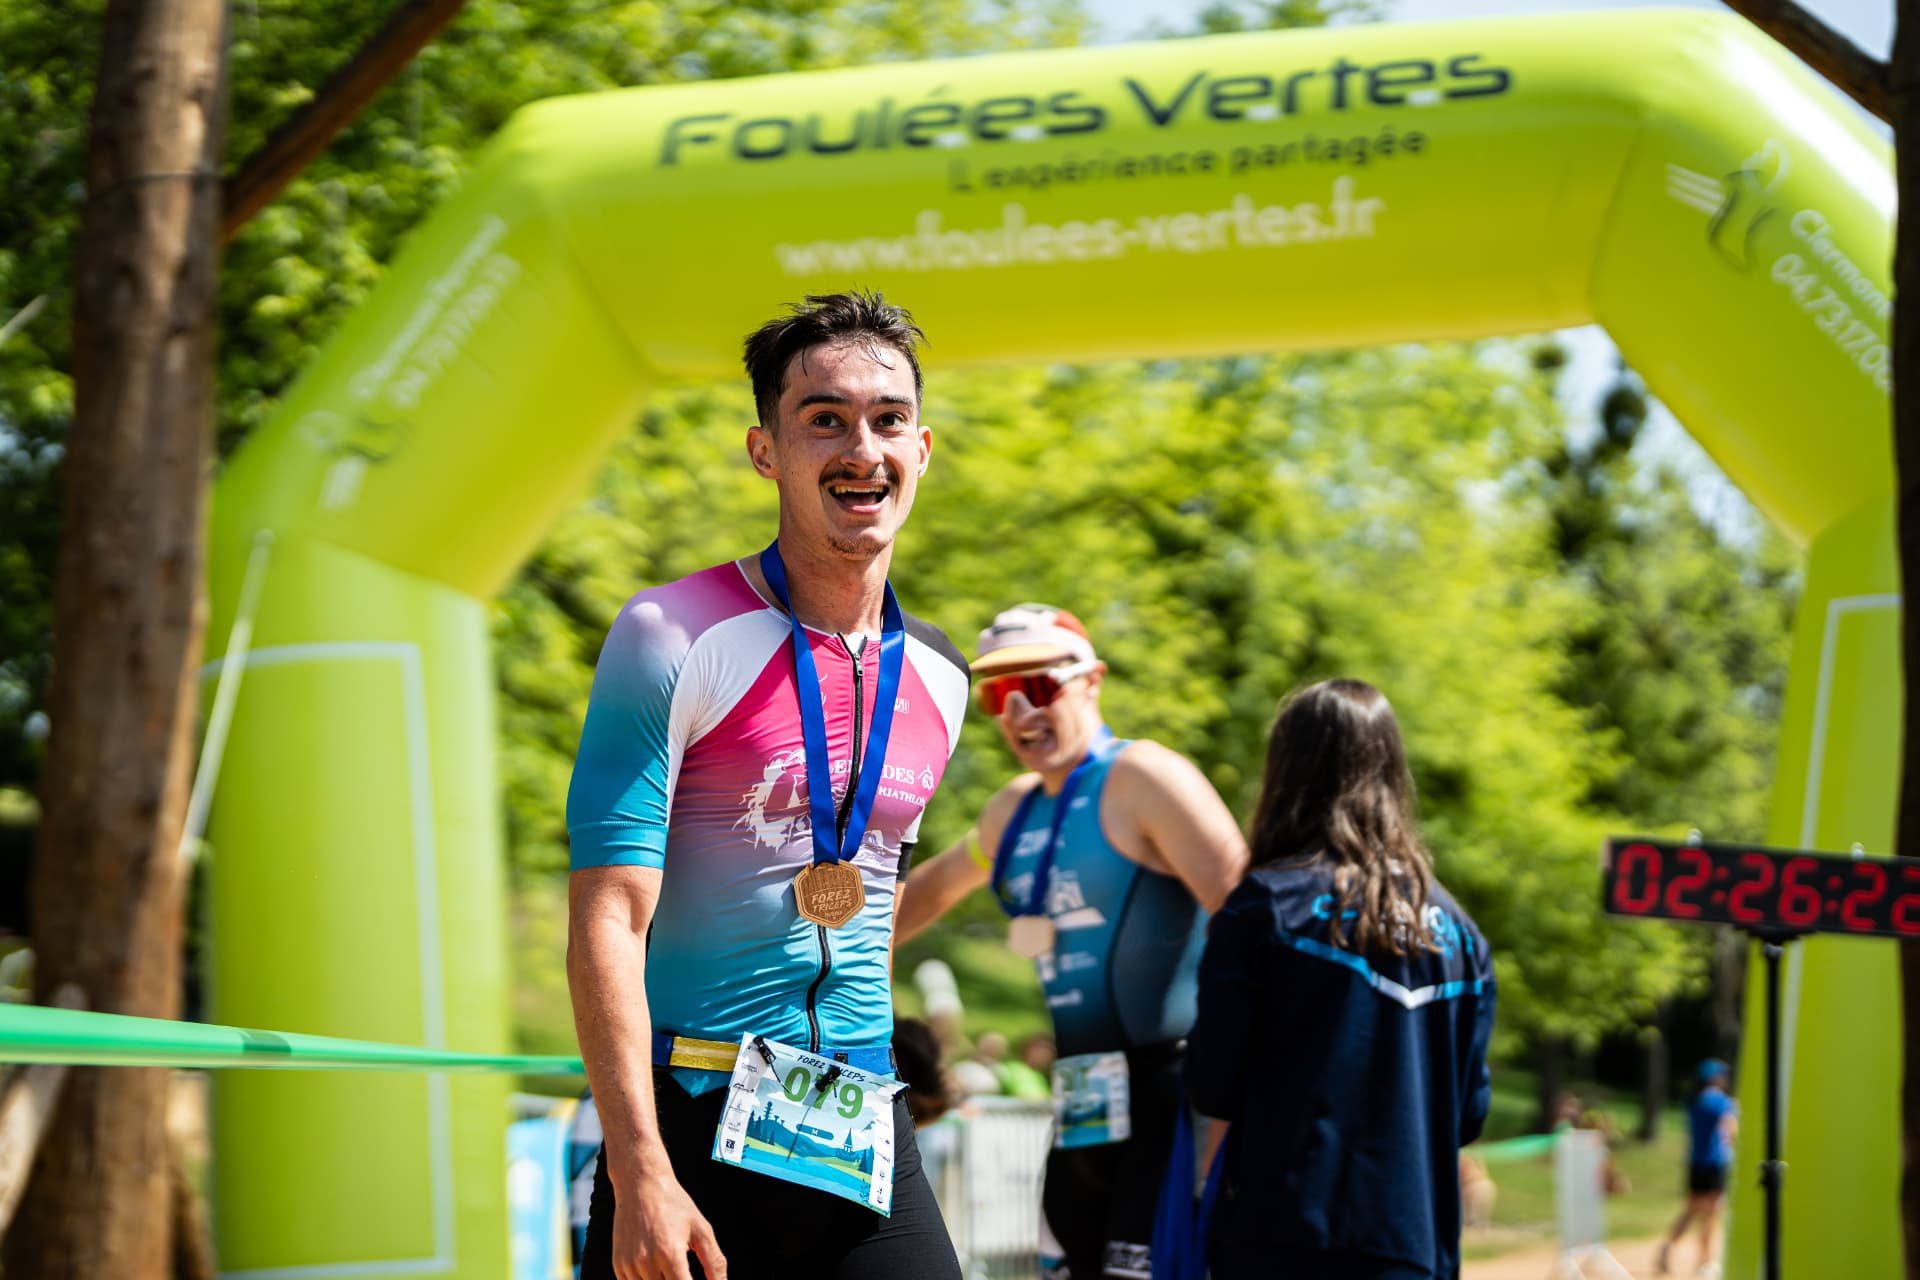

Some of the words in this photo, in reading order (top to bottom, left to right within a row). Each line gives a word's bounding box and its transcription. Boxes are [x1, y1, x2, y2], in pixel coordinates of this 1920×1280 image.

[659, 86, 1110, 166] Foulées
[1123, 54, 1513, 127] Vertes
[1228, 123, 1432, 178] partagée
[774, 175, 1385, 277] www.foulees-vertes.fr
[811, 889, 850, 905] FOREZ
[1613, 844, 1920, 935] 02:26:22
[797, 1055, 826, 1069] FOREZ
[784, 1067, 863, 1119] 079
